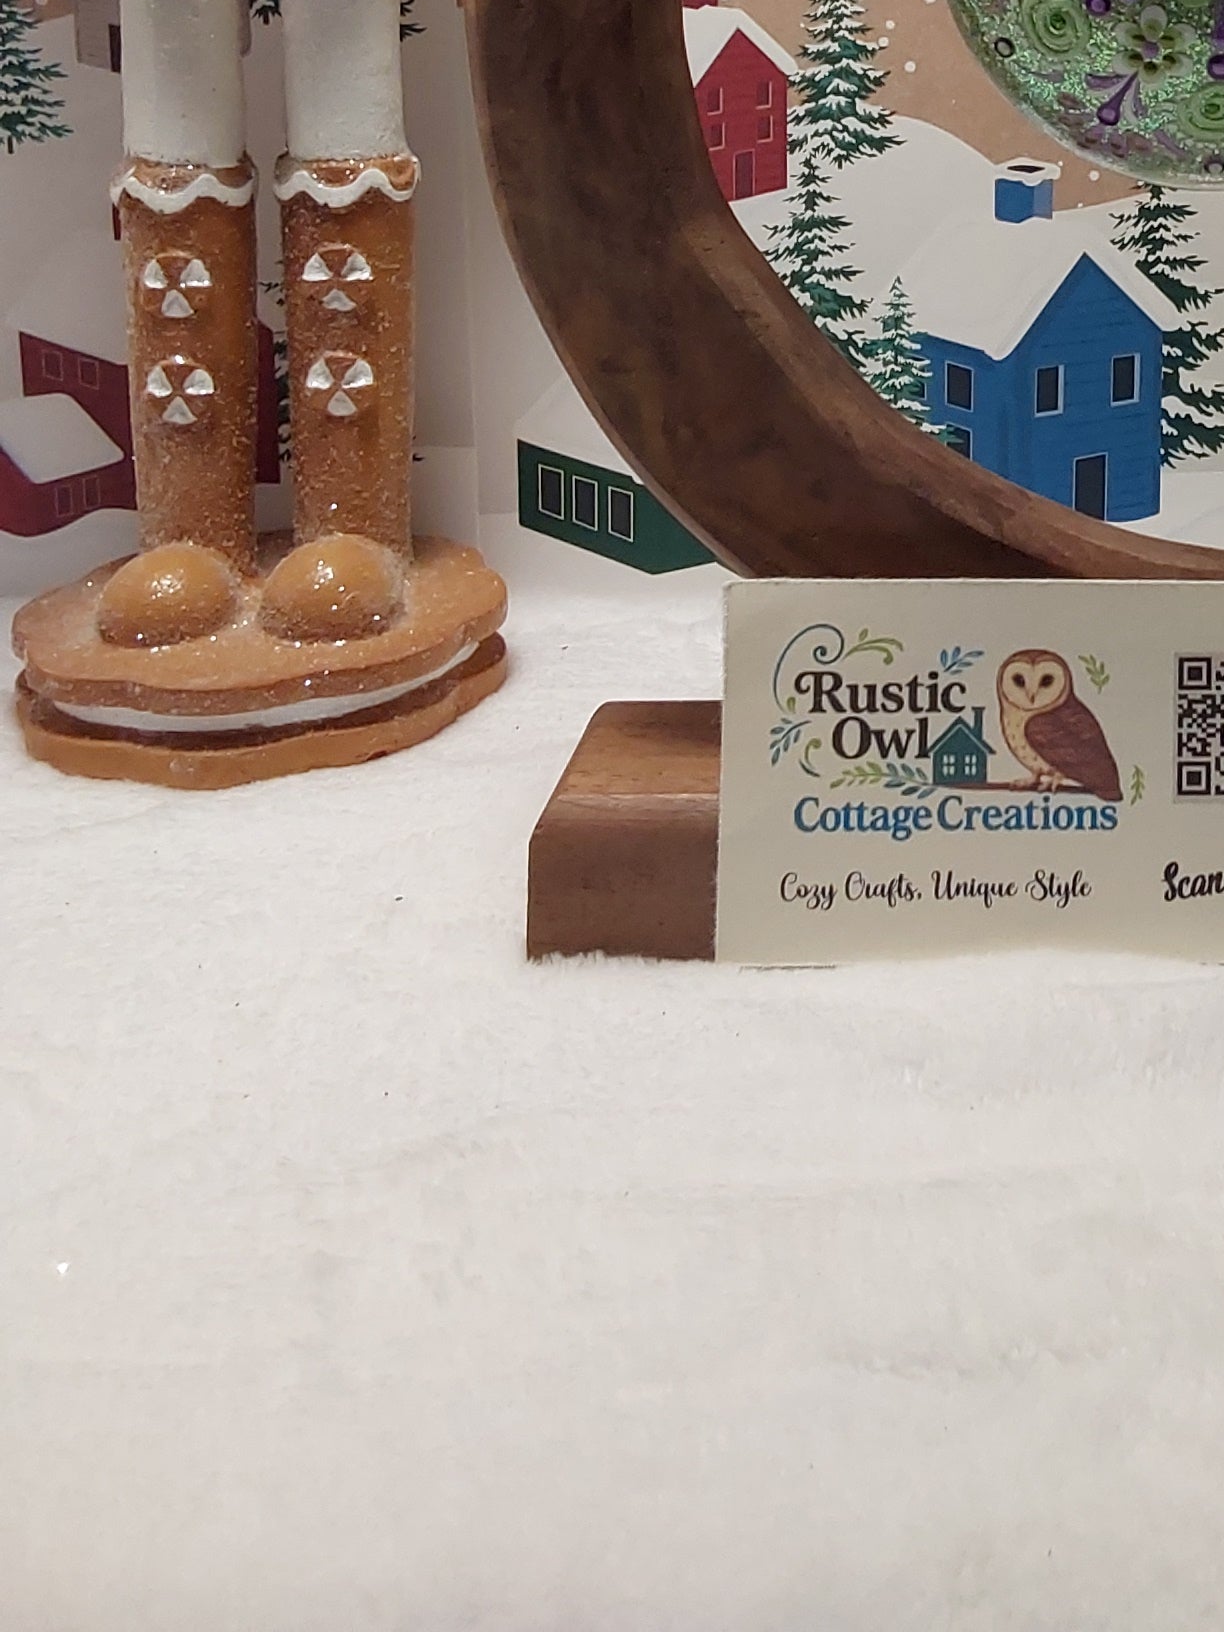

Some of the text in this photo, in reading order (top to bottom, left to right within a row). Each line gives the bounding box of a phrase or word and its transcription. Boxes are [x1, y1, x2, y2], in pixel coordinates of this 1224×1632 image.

[794, 670, 967, 714] Rustic
[832, 715, 931, 759] Owl
[793, 794, 1119, 841] Cottage Creations
[780, 869, 1092, 910] Cozy Crafts, Unique Style
